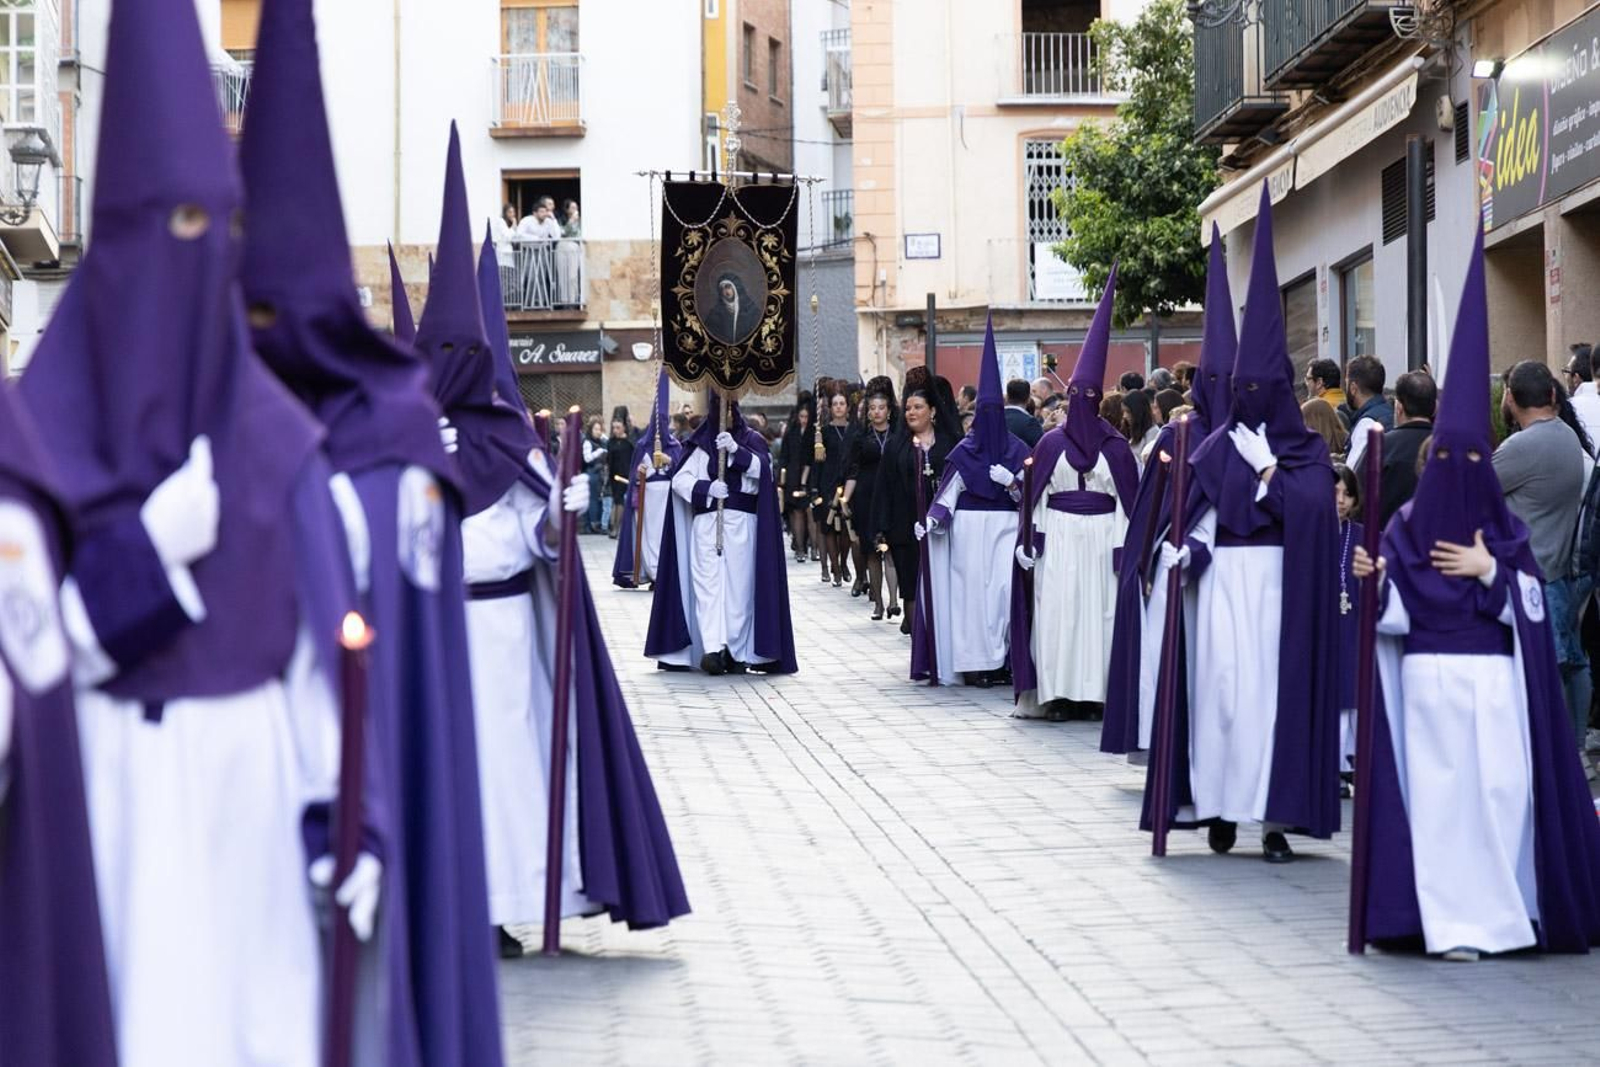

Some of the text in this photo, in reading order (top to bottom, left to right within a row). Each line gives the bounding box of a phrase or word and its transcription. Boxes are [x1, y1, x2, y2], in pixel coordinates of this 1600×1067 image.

[1497, 87, 1540, 191] idea
[519, 342, 599, 364] A. Suarez
